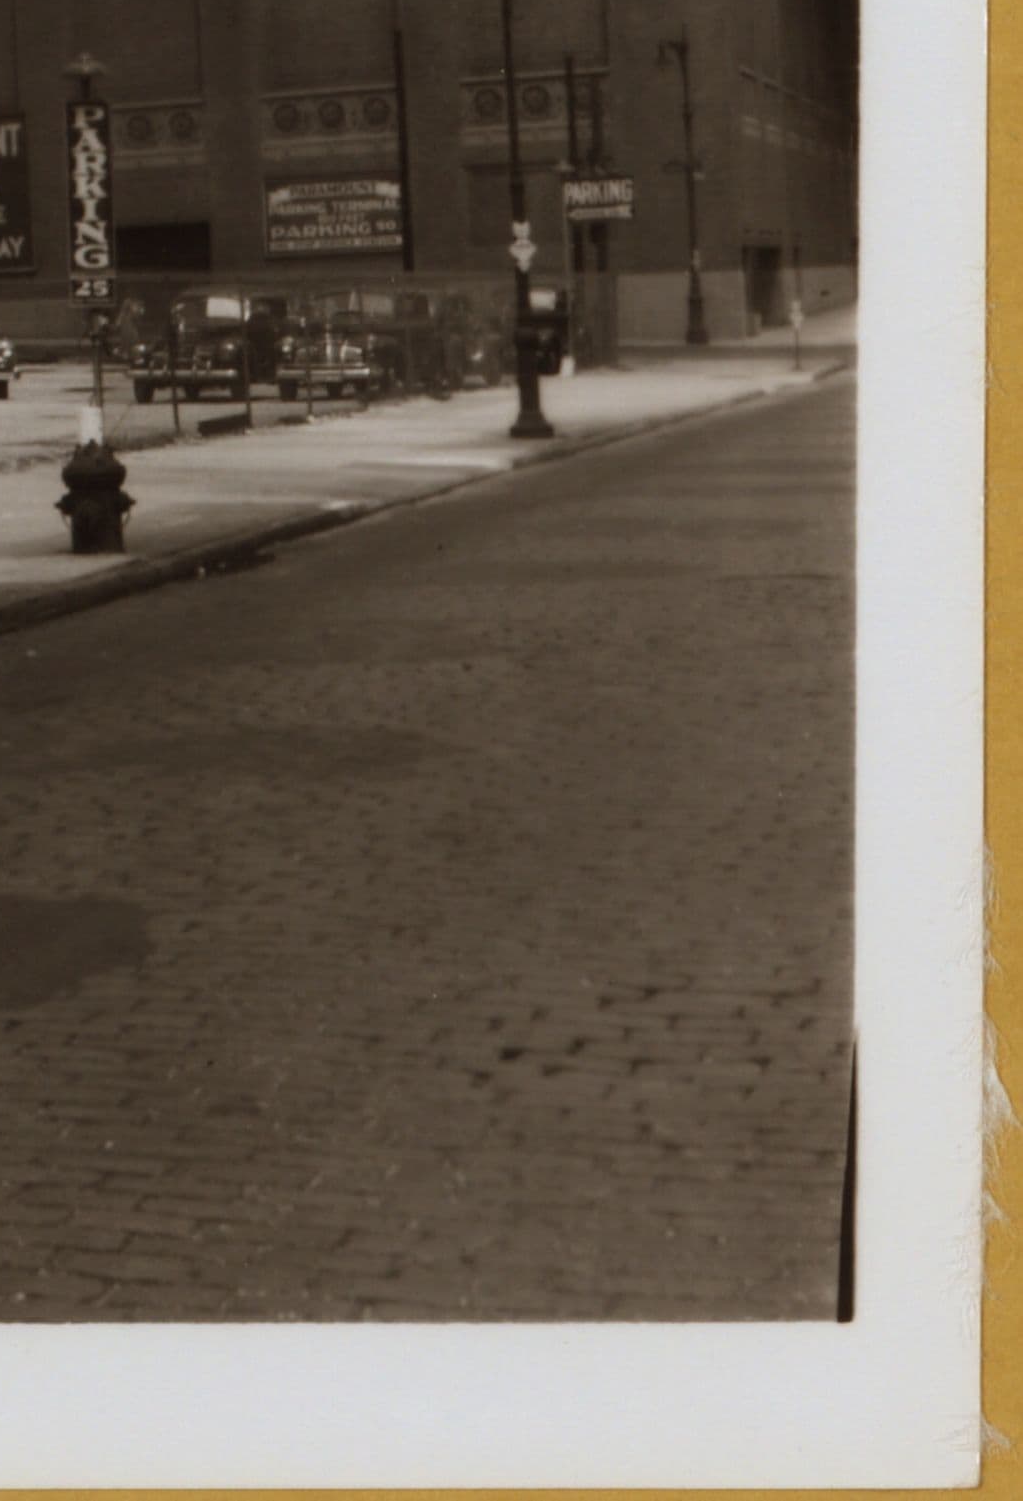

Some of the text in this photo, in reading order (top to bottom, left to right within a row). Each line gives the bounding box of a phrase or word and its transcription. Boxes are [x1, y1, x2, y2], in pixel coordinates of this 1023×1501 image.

[73, 105, 109, 269] PARKING
[564, 179, 633, 205] PARKING
[271, 220, 371, 240] PARKING
[75, 279, 108, 298] 25
